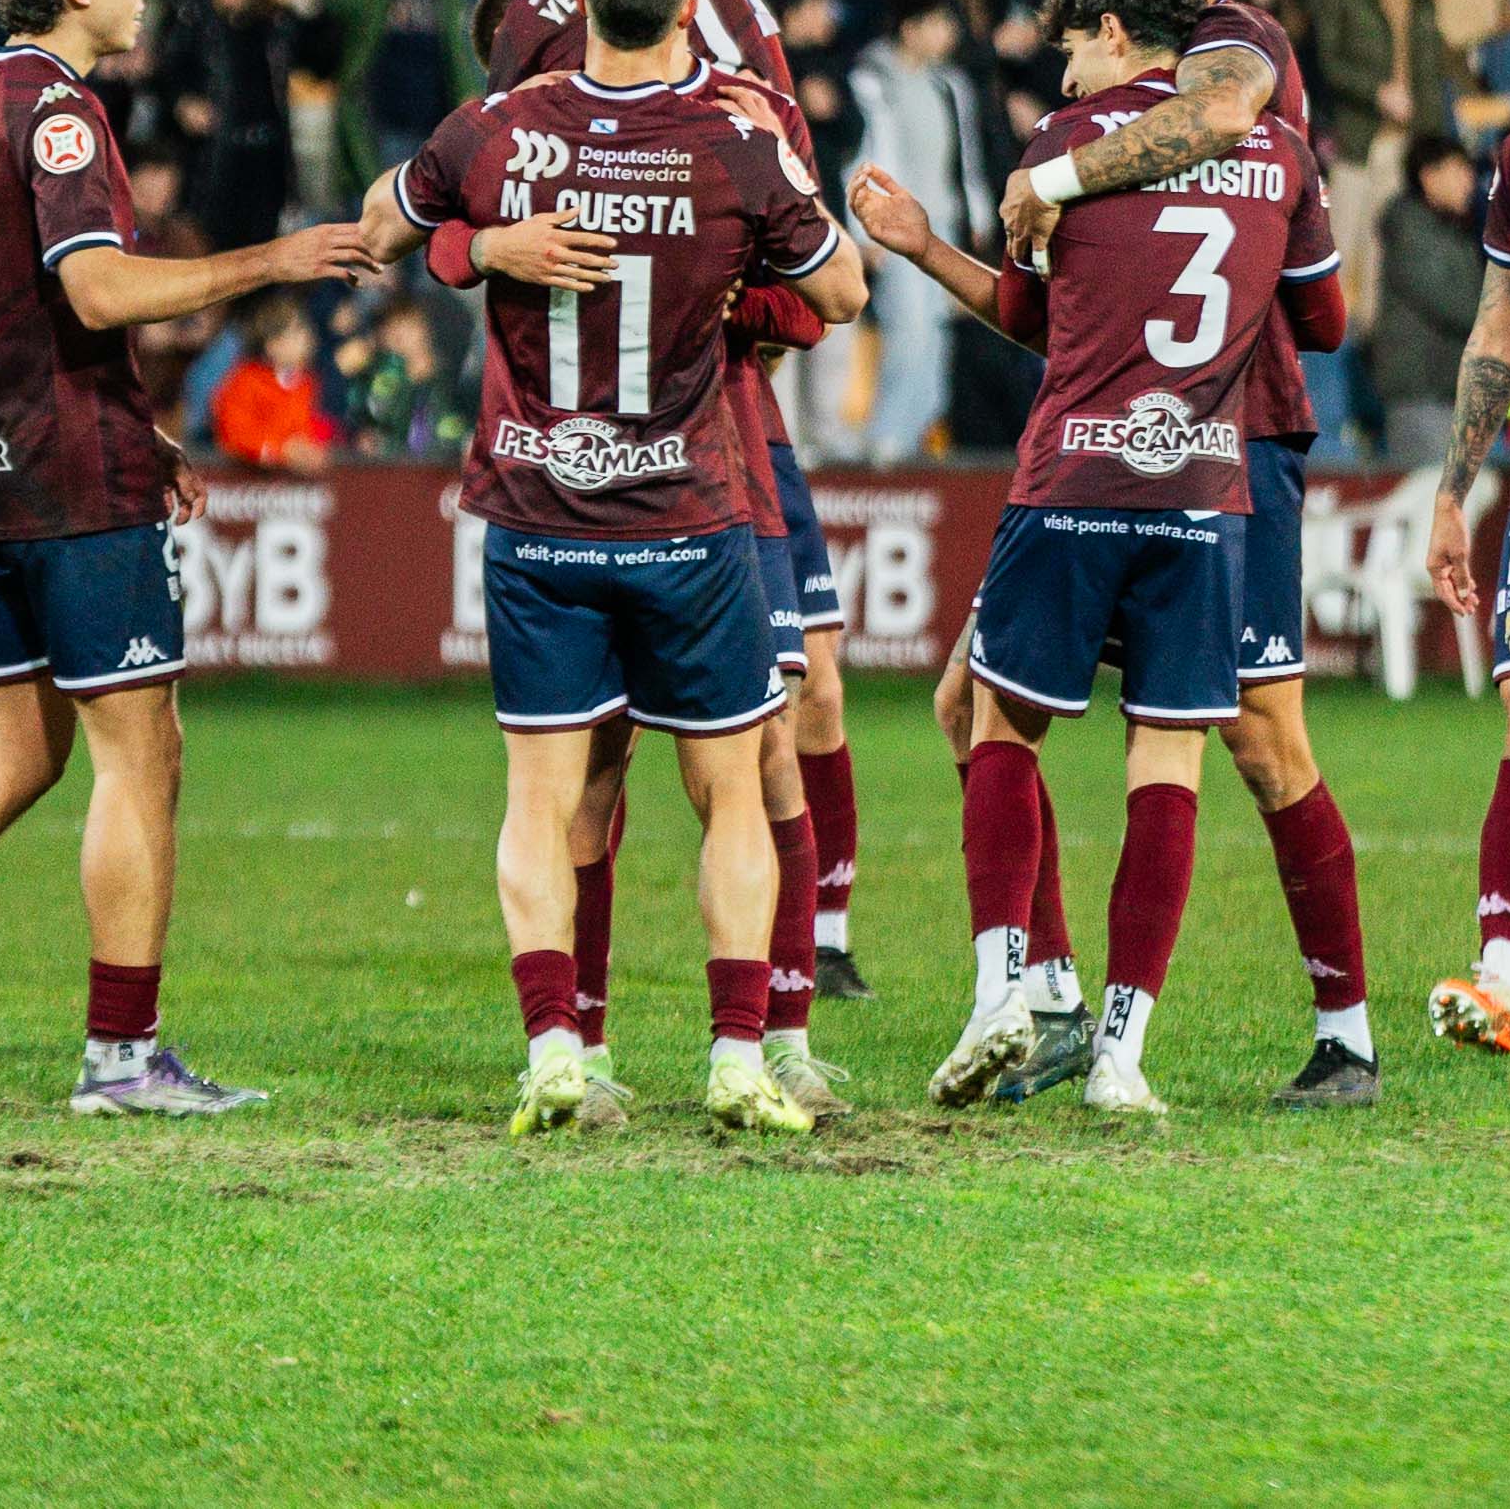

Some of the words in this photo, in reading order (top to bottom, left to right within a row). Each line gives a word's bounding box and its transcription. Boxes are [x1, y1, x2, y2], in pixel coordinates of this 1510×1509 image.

[578, 144, 692, 170] Deputación
[577, 162, 692, 182] Pontevedra
[1141, 157, 1286, 202] POSITO
[1144, 206, 1237, 368] 3
[1130, 392, 1193, 418] CONSERVAS
[549, 417, 618, 439] CONSERVAS
[1062, 417, 1241, 461] PESCAMAR
